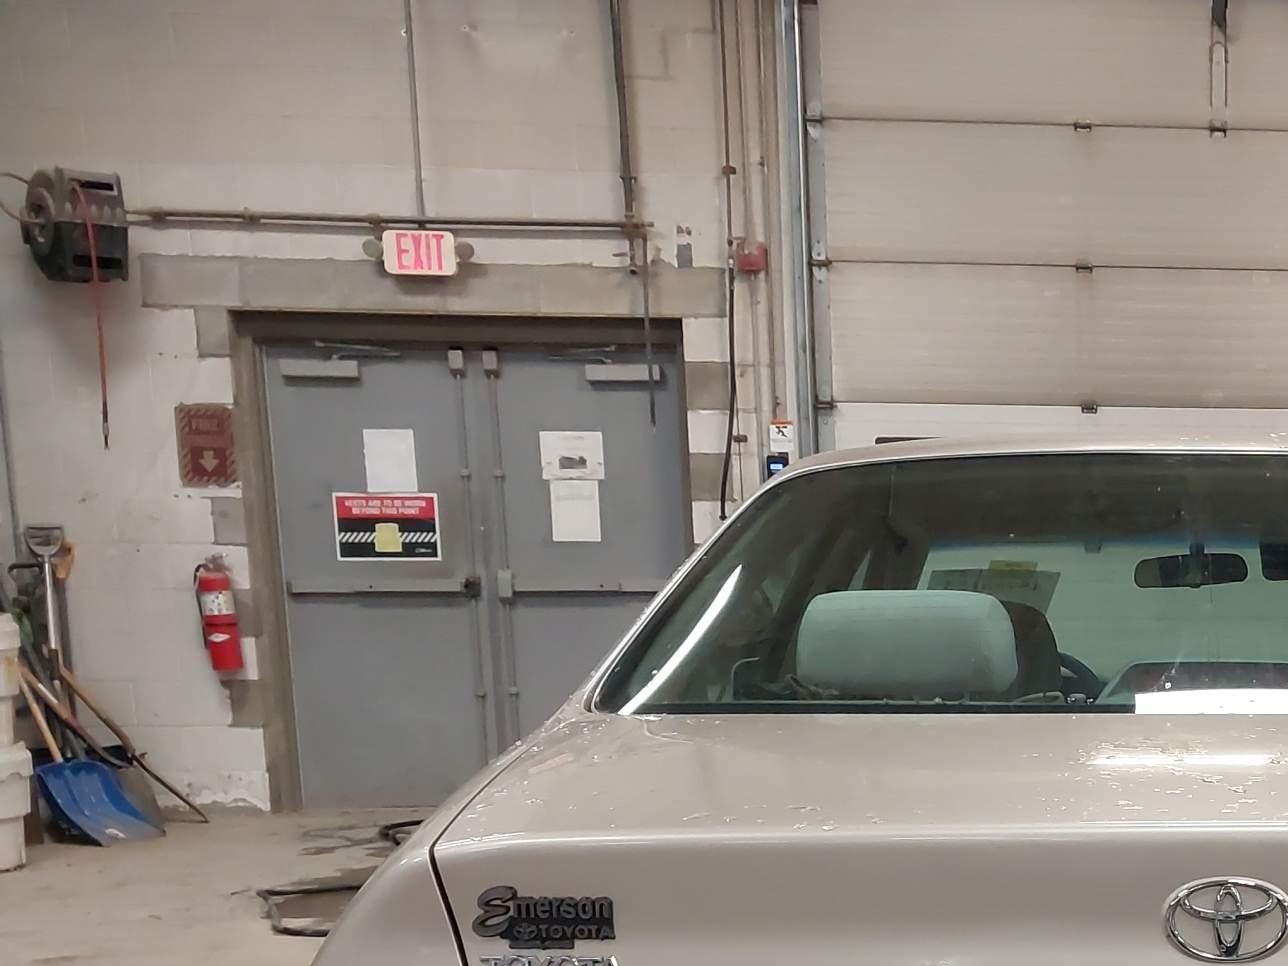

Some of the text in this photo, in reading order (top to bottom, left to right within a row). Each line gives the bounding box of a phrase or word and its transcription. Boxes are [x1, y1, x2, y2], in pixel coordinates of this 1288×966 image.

[395, 232, 445, 272] EXIT
[472, 885, 612, 937] Emerson
[538, 924, 614, 939] TOYOTA
